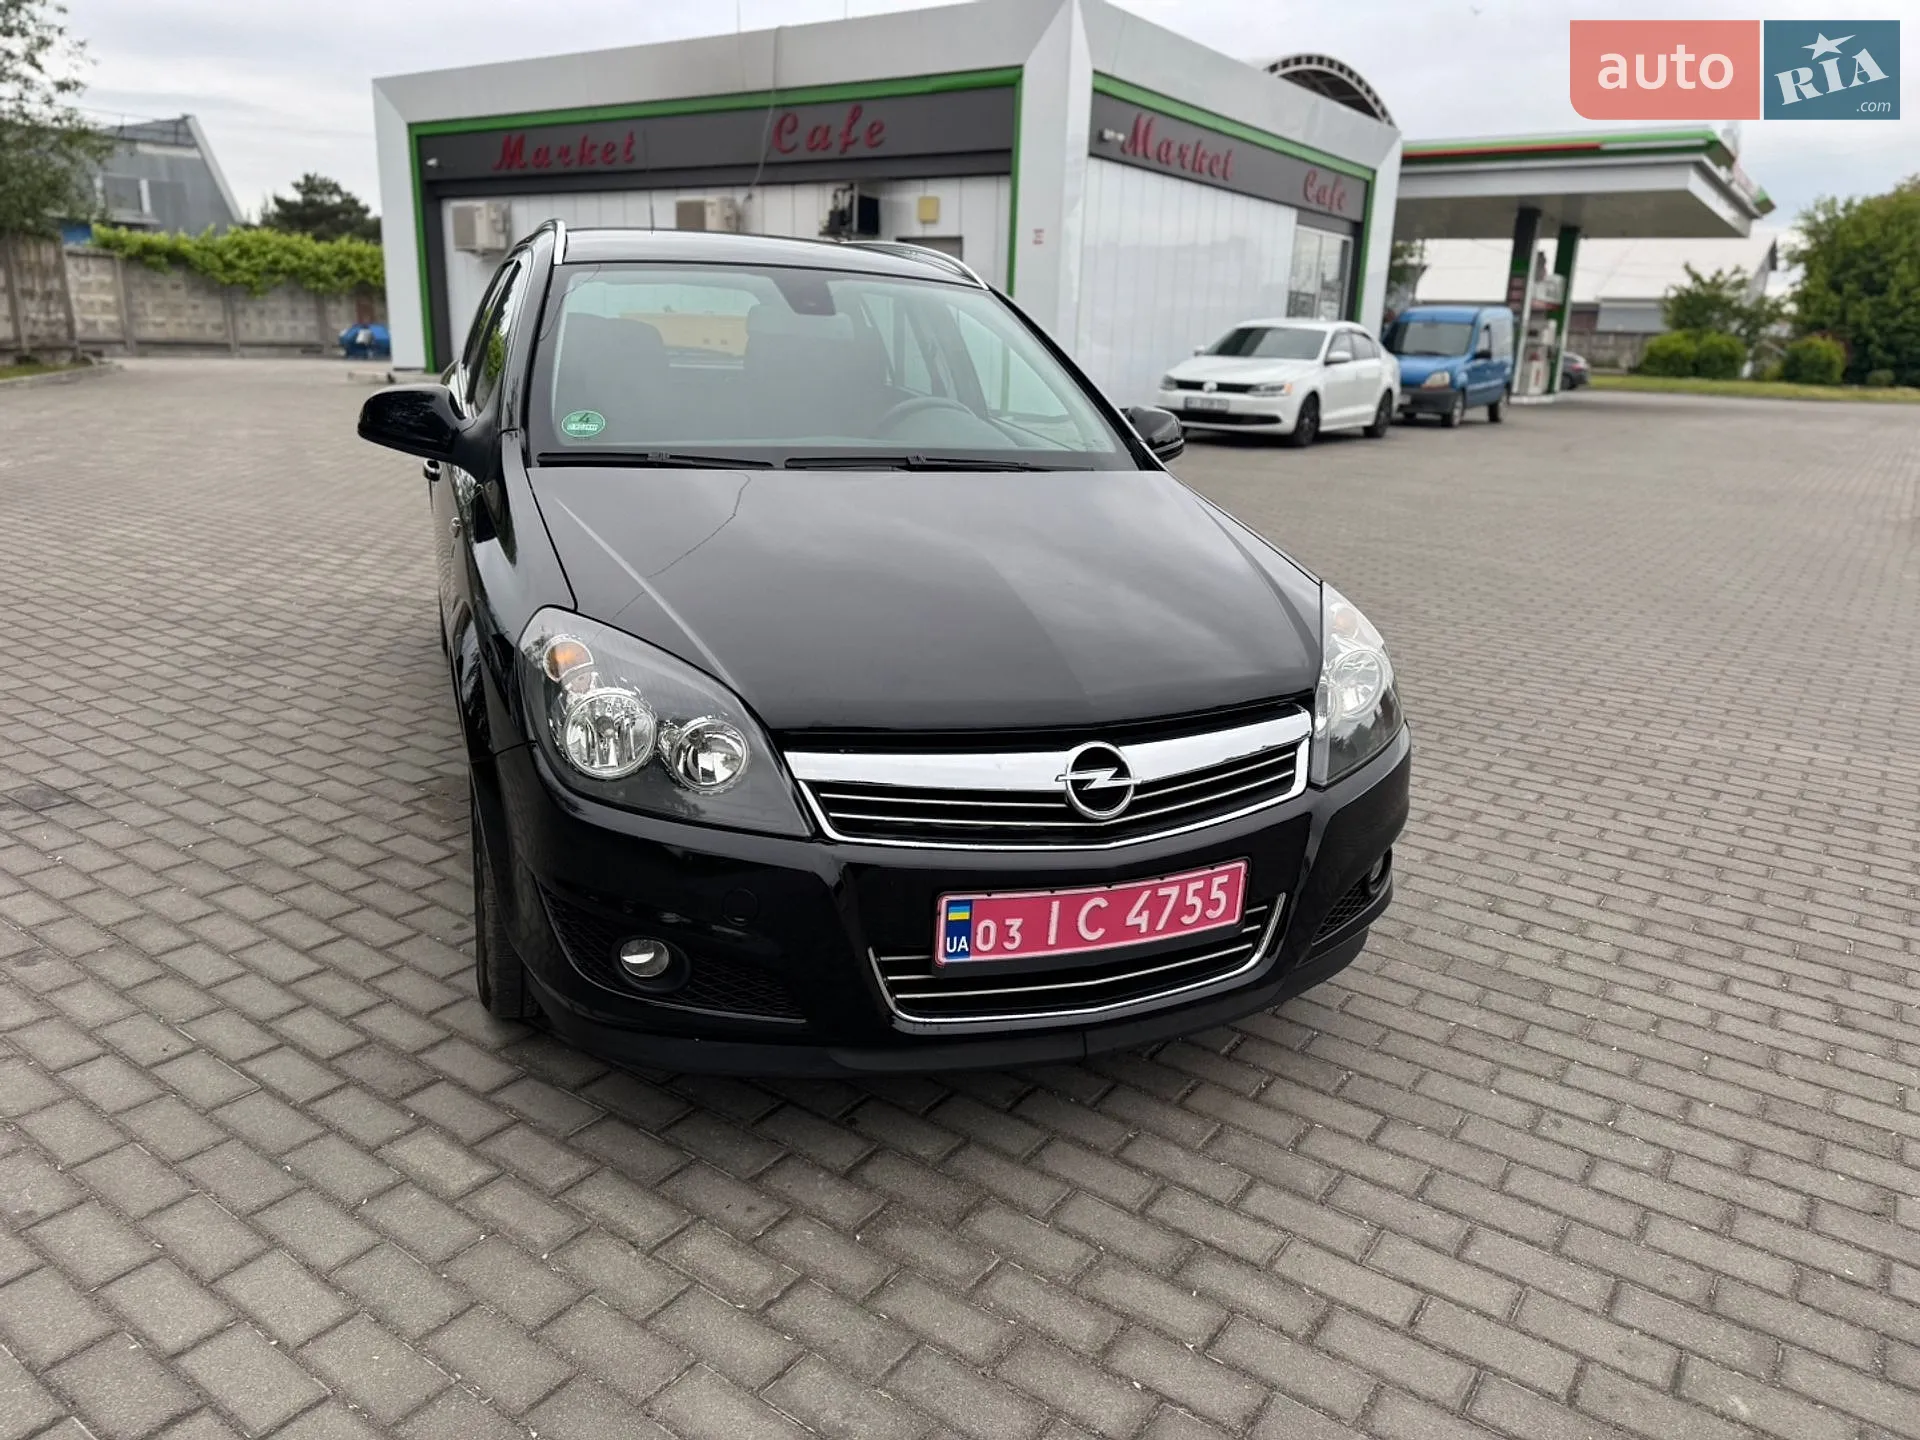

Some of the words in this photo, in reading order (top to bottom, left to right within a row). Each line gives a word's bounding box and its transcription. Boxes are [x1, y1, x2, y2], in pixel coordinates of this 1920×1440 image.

[494, 131, 637, 169] Market
[773, 104, 886, 154] Cafe
[1120, 112, 1234, 181] Market
[1303, 168, 1347, 212] Cafe
[946, 935, 969, 953] UA
[975, 918, 1023, 952] 03
[1126, 876, 1229, 935] 4755
